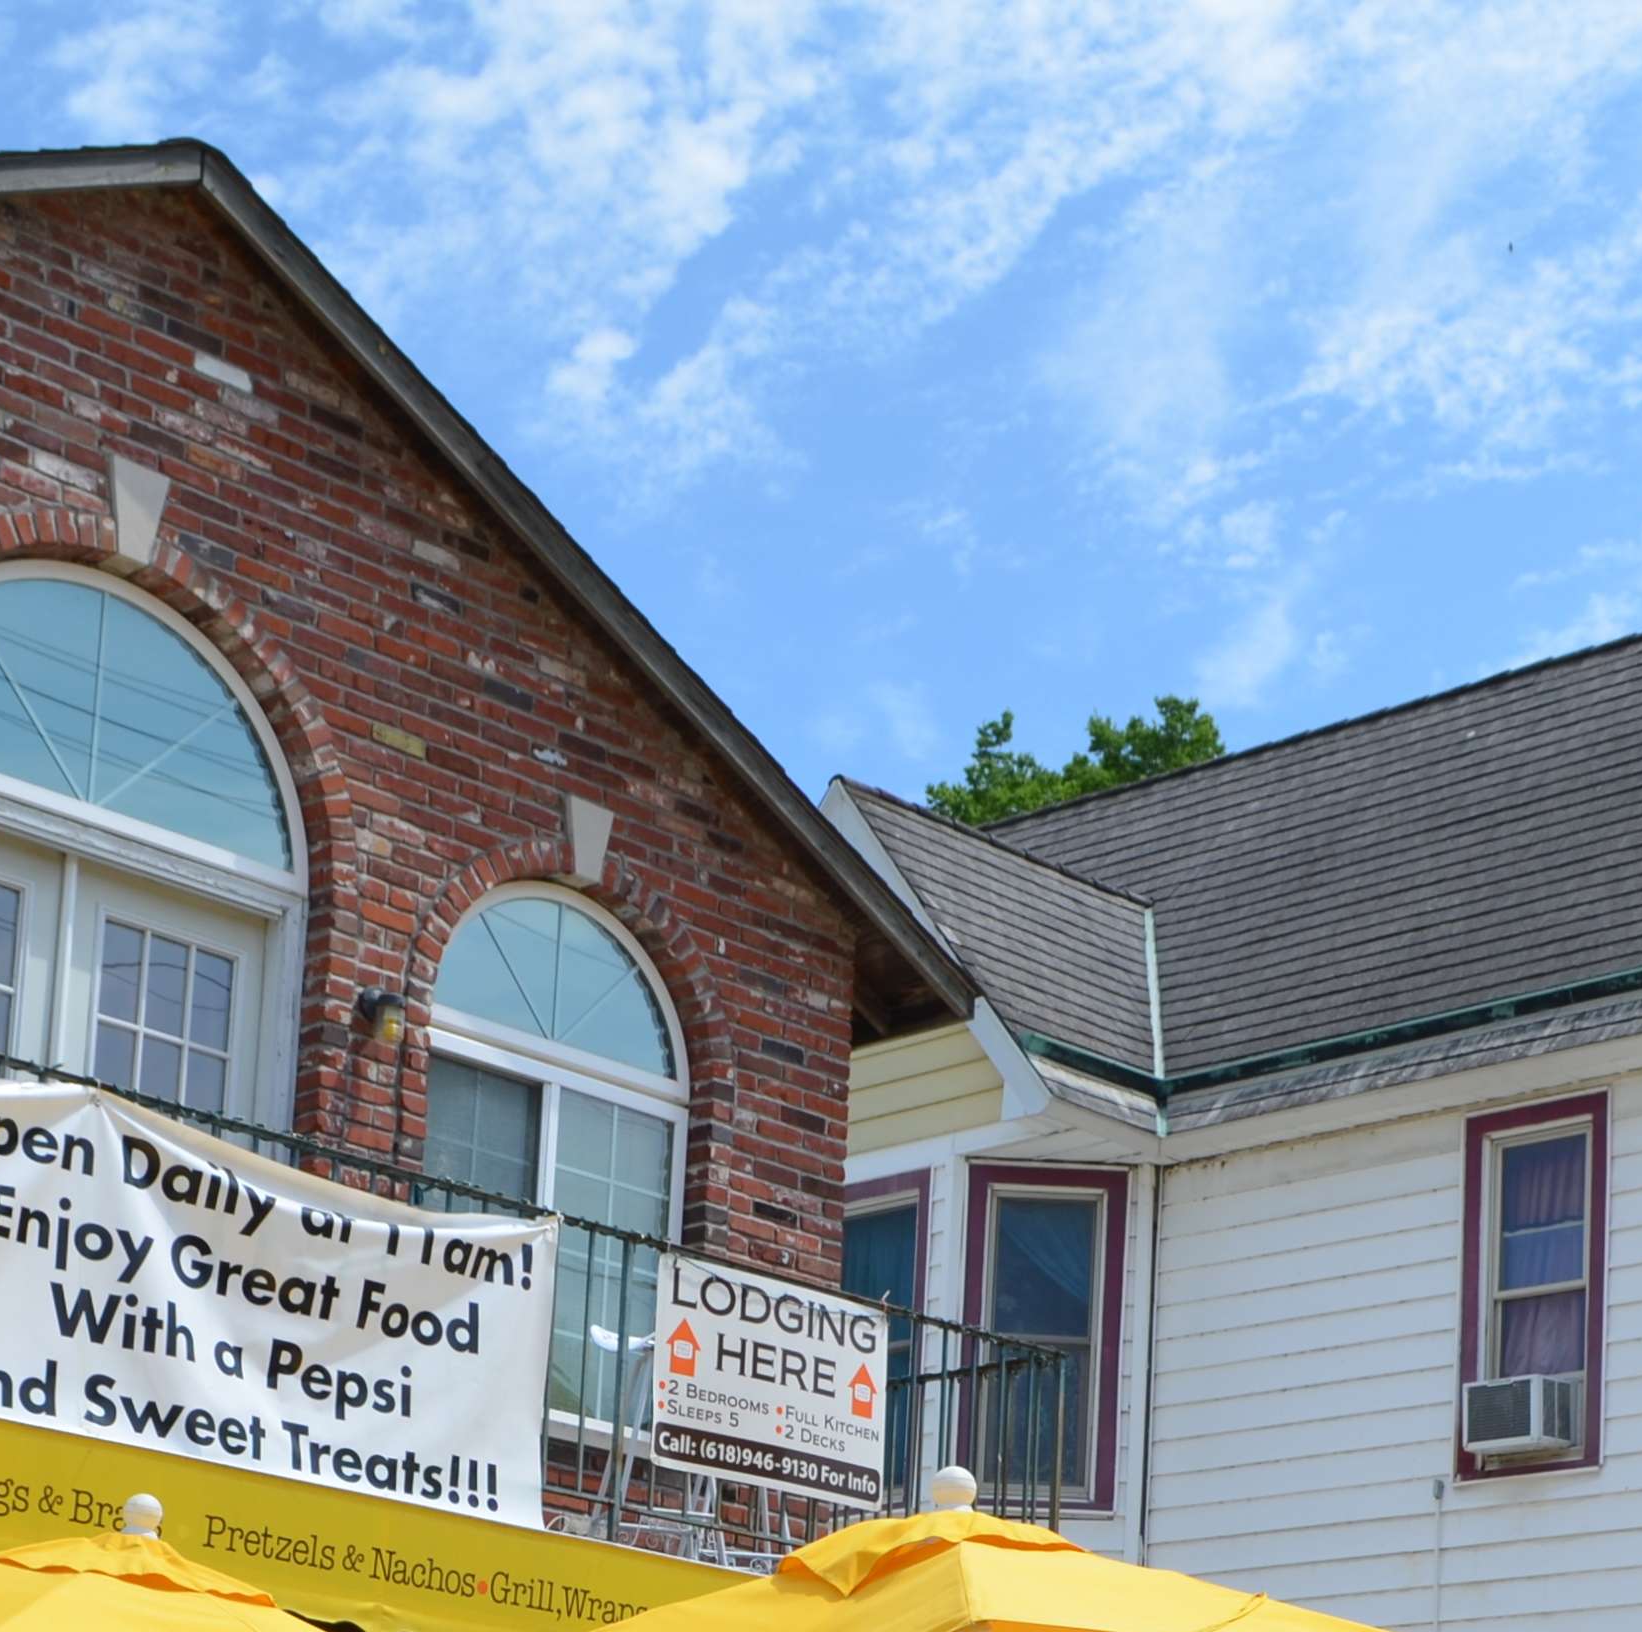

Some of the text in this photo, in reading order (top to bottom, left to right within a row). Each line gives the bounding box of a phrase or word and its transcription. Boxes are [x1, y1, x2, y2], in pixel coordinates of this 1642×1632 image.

[122, 1135, 276, 1236] Daily
[170, 1233, 339, 1321] Great
[356, 1281, 479, 1355] Food
[671, 1267, 877, 1354] LODGING
[50, 1281, 411, 1420] With a Pepsi
[668, 1380, 679, 1395] 2
[716, 1332, 836, 1398] HERE
[84, 1373, 264, 1461] Sweet
[280, 1420, 500, 1513] Treats!!!
[659, 1431, 877, 1495] Call: (618)946-9130 For Info
[729, 1412, 739, 1427] 5
[785, 1425, 794, 1440] 2
[38, 1485, 63, 1515] &
[203, 1515, 335, 1571] Pretzels
[342, 1544, 364, 1573] &
[370, 1546, 475, 1597] Nachos
